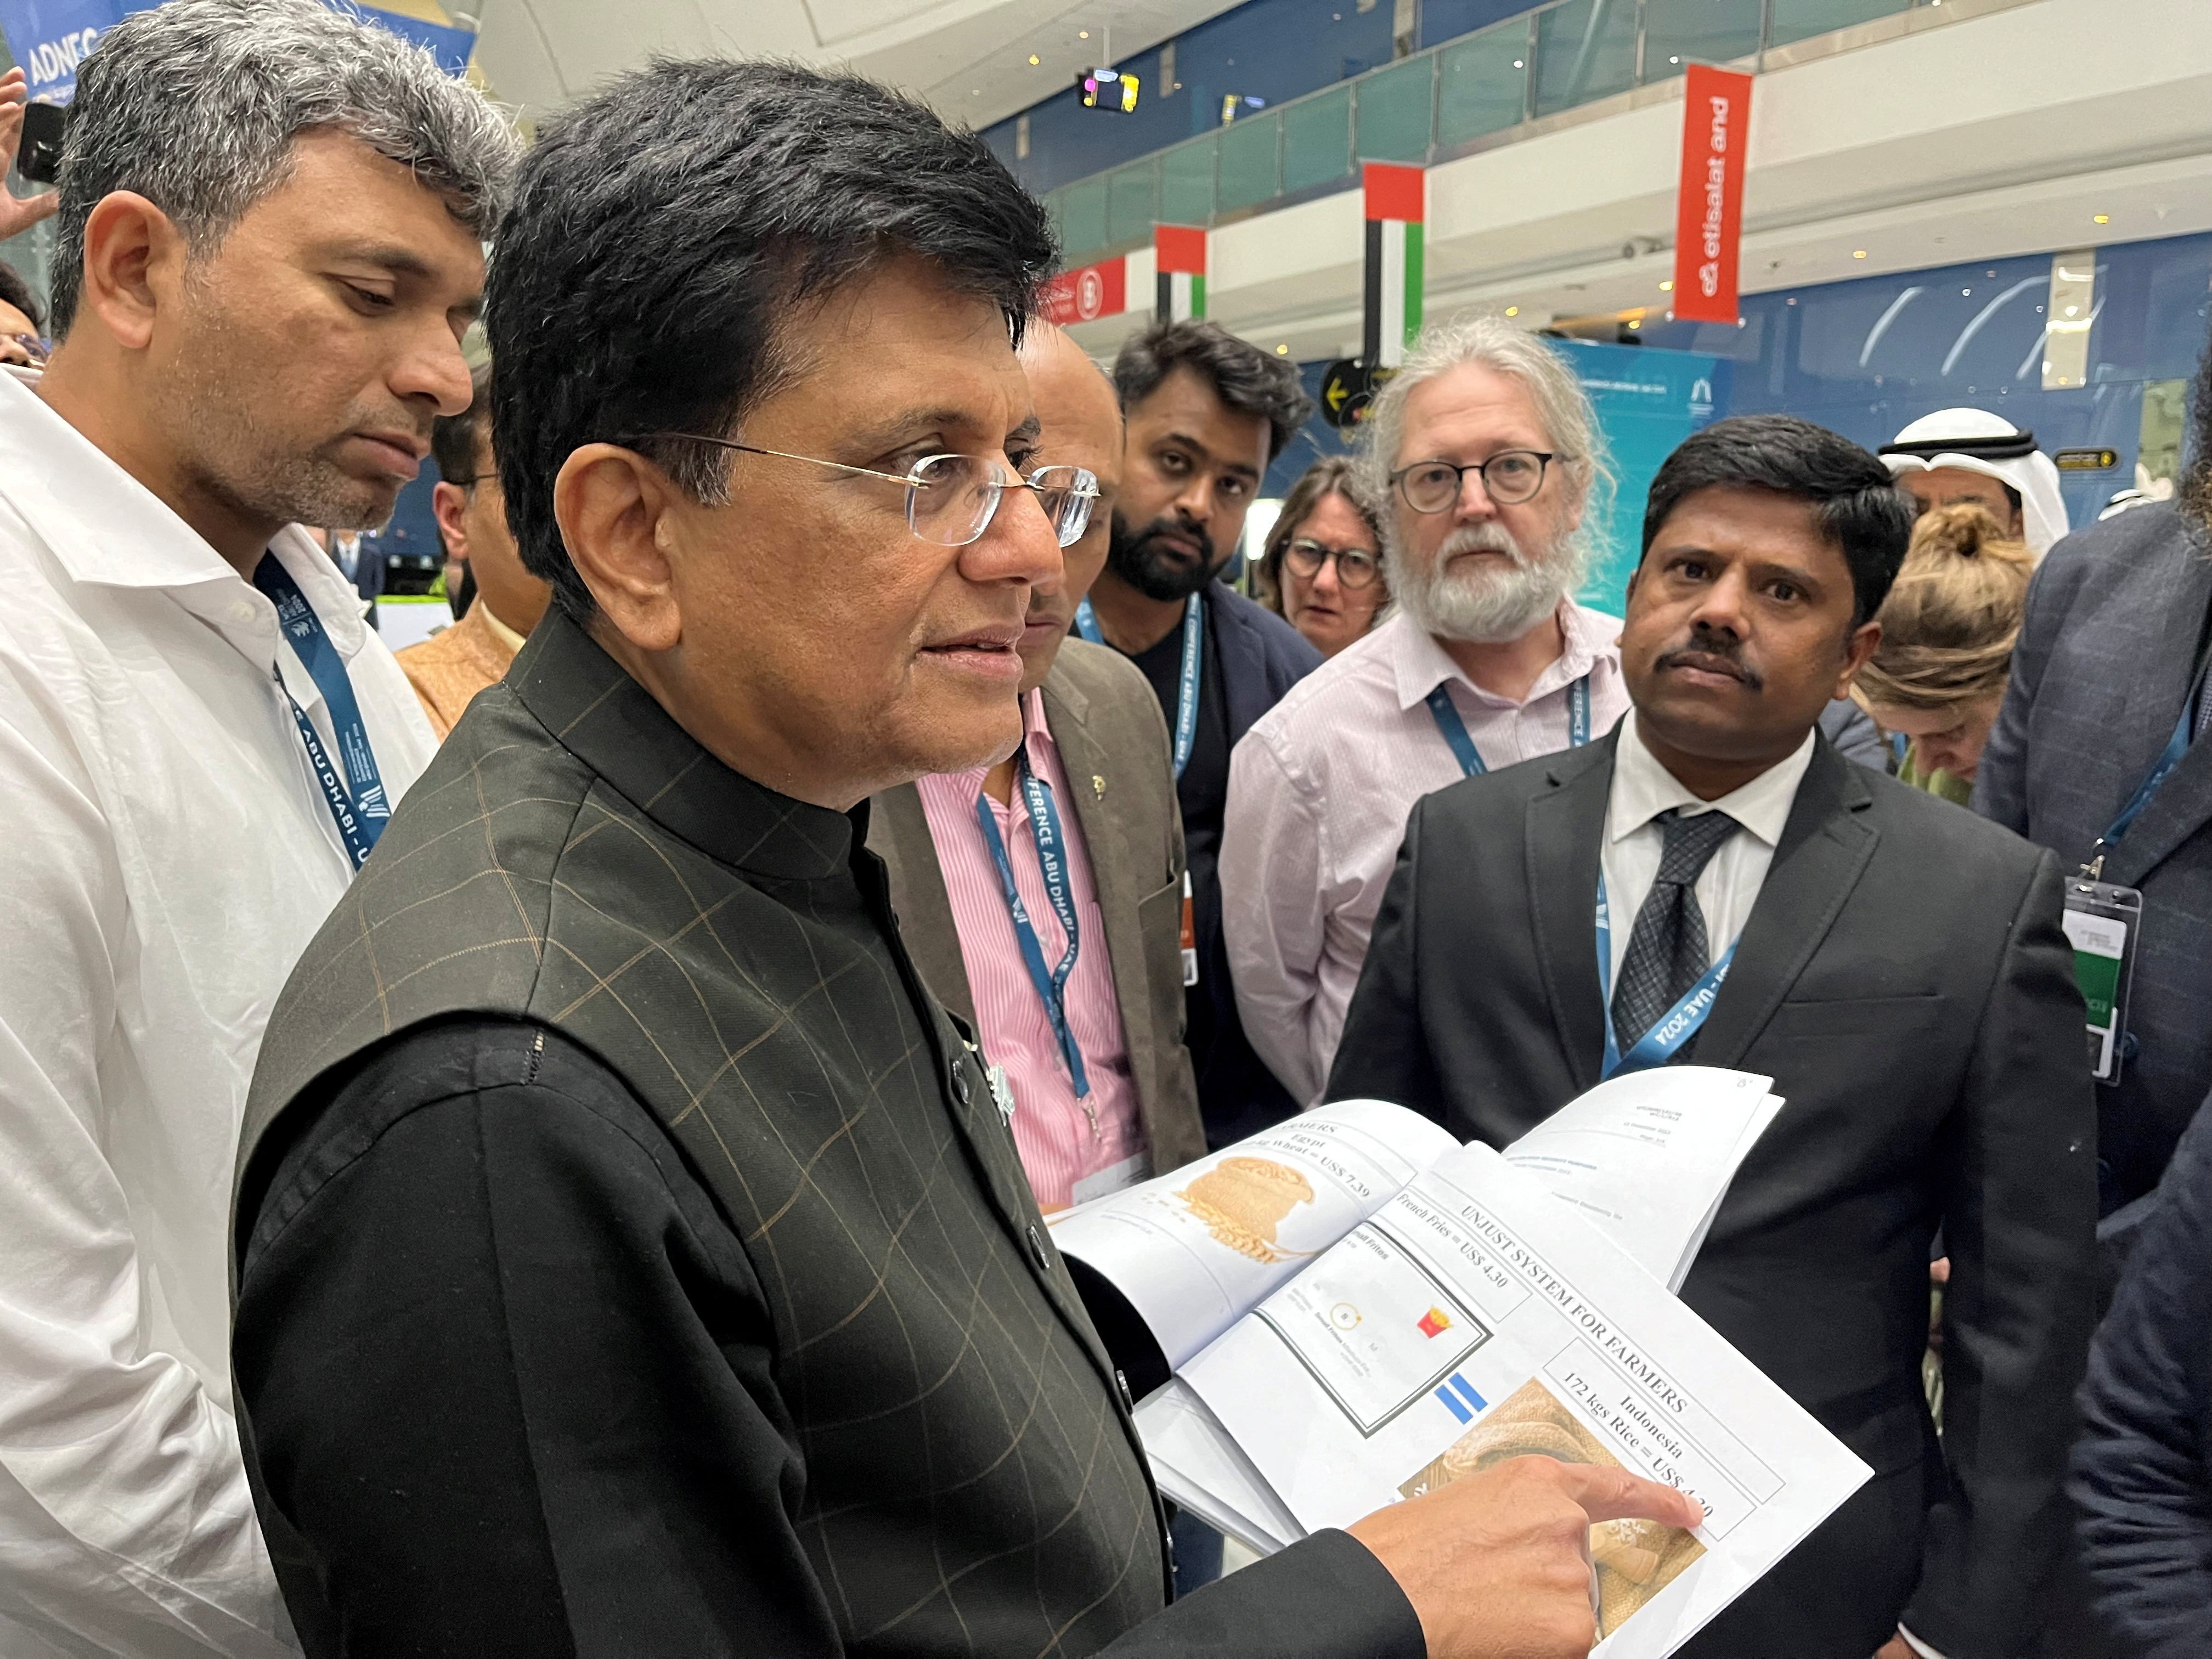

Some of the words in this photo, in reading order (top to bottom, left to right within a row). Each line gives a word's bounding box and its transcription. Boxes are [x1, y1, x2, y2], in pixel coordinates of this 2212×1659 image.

[1709, 96, 1729, 153] and
[1702, 155, 1725, 259] etisalat
[303, 729, 326, 768] ABU
[323, 772, 357, 834] DHABI
[1043, 851, 1059, 882] ABU
[1051, 886, 1074, 930] DHABI
[1655, 1012, 1689, 1046] 2024
[1683, 988, 1716, 1017] UAE
[1273, 1140, 1308, 1154] Wheat
[1345, 1175, 1370, 1198] 7.39
[1291, 1133, 1327, 1148] Egypt
[1397, 1193, 1427, 1218] French
[1426, 1215, 1452, 1237] Fries
[1483, 1265, 1508, 1288] 4.30
[1461, 1205, 1515, 1250] UNJUST
[1510, 1249, 1574, 1306] SYSTEM
[1570, 1304, 1606, 1339] FOR
[1604, 1336, 1688, 1413] FARMERS
[1564, 1373, 1589, 1396] 172
[1586, 1393, 1610, 1418] kgs
[1610, 1416, 1639, 1448] Rice
[1620, 1396, 1683, 1459] Indonesia
